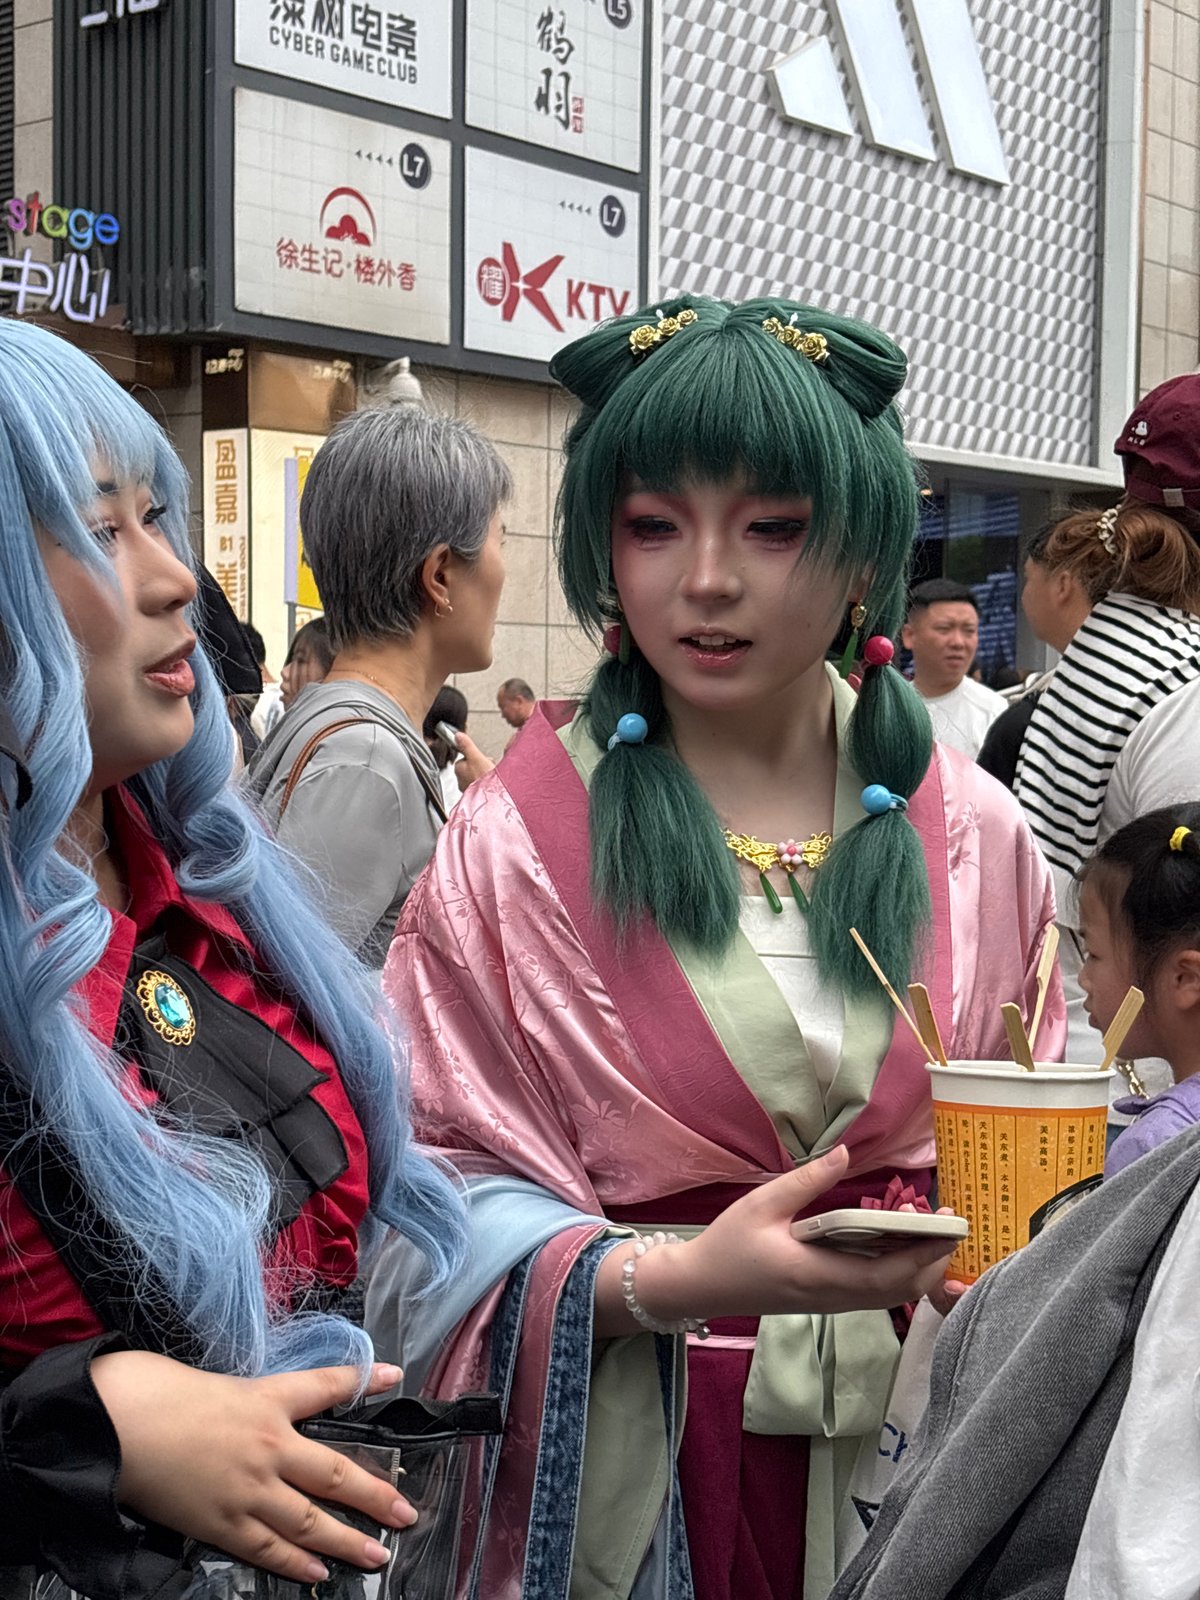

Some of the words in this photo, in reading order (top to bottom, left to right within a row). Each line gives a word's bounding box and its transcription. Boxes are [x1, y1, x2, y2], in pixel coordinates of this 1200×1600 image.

[607, 0, 628, 20] L5
[269, 26, 325, 60] CYBER
[330, 44, 374, 73] GAME
[377, 57, 418, 84] CLUB
[402, 152, 425, 179] L7
[8, 190, 120, 250] stage
[602, 203, 622, 228] L7
[567, 278, 630, 322] KTV
[219, 535, 233, 551] B1
